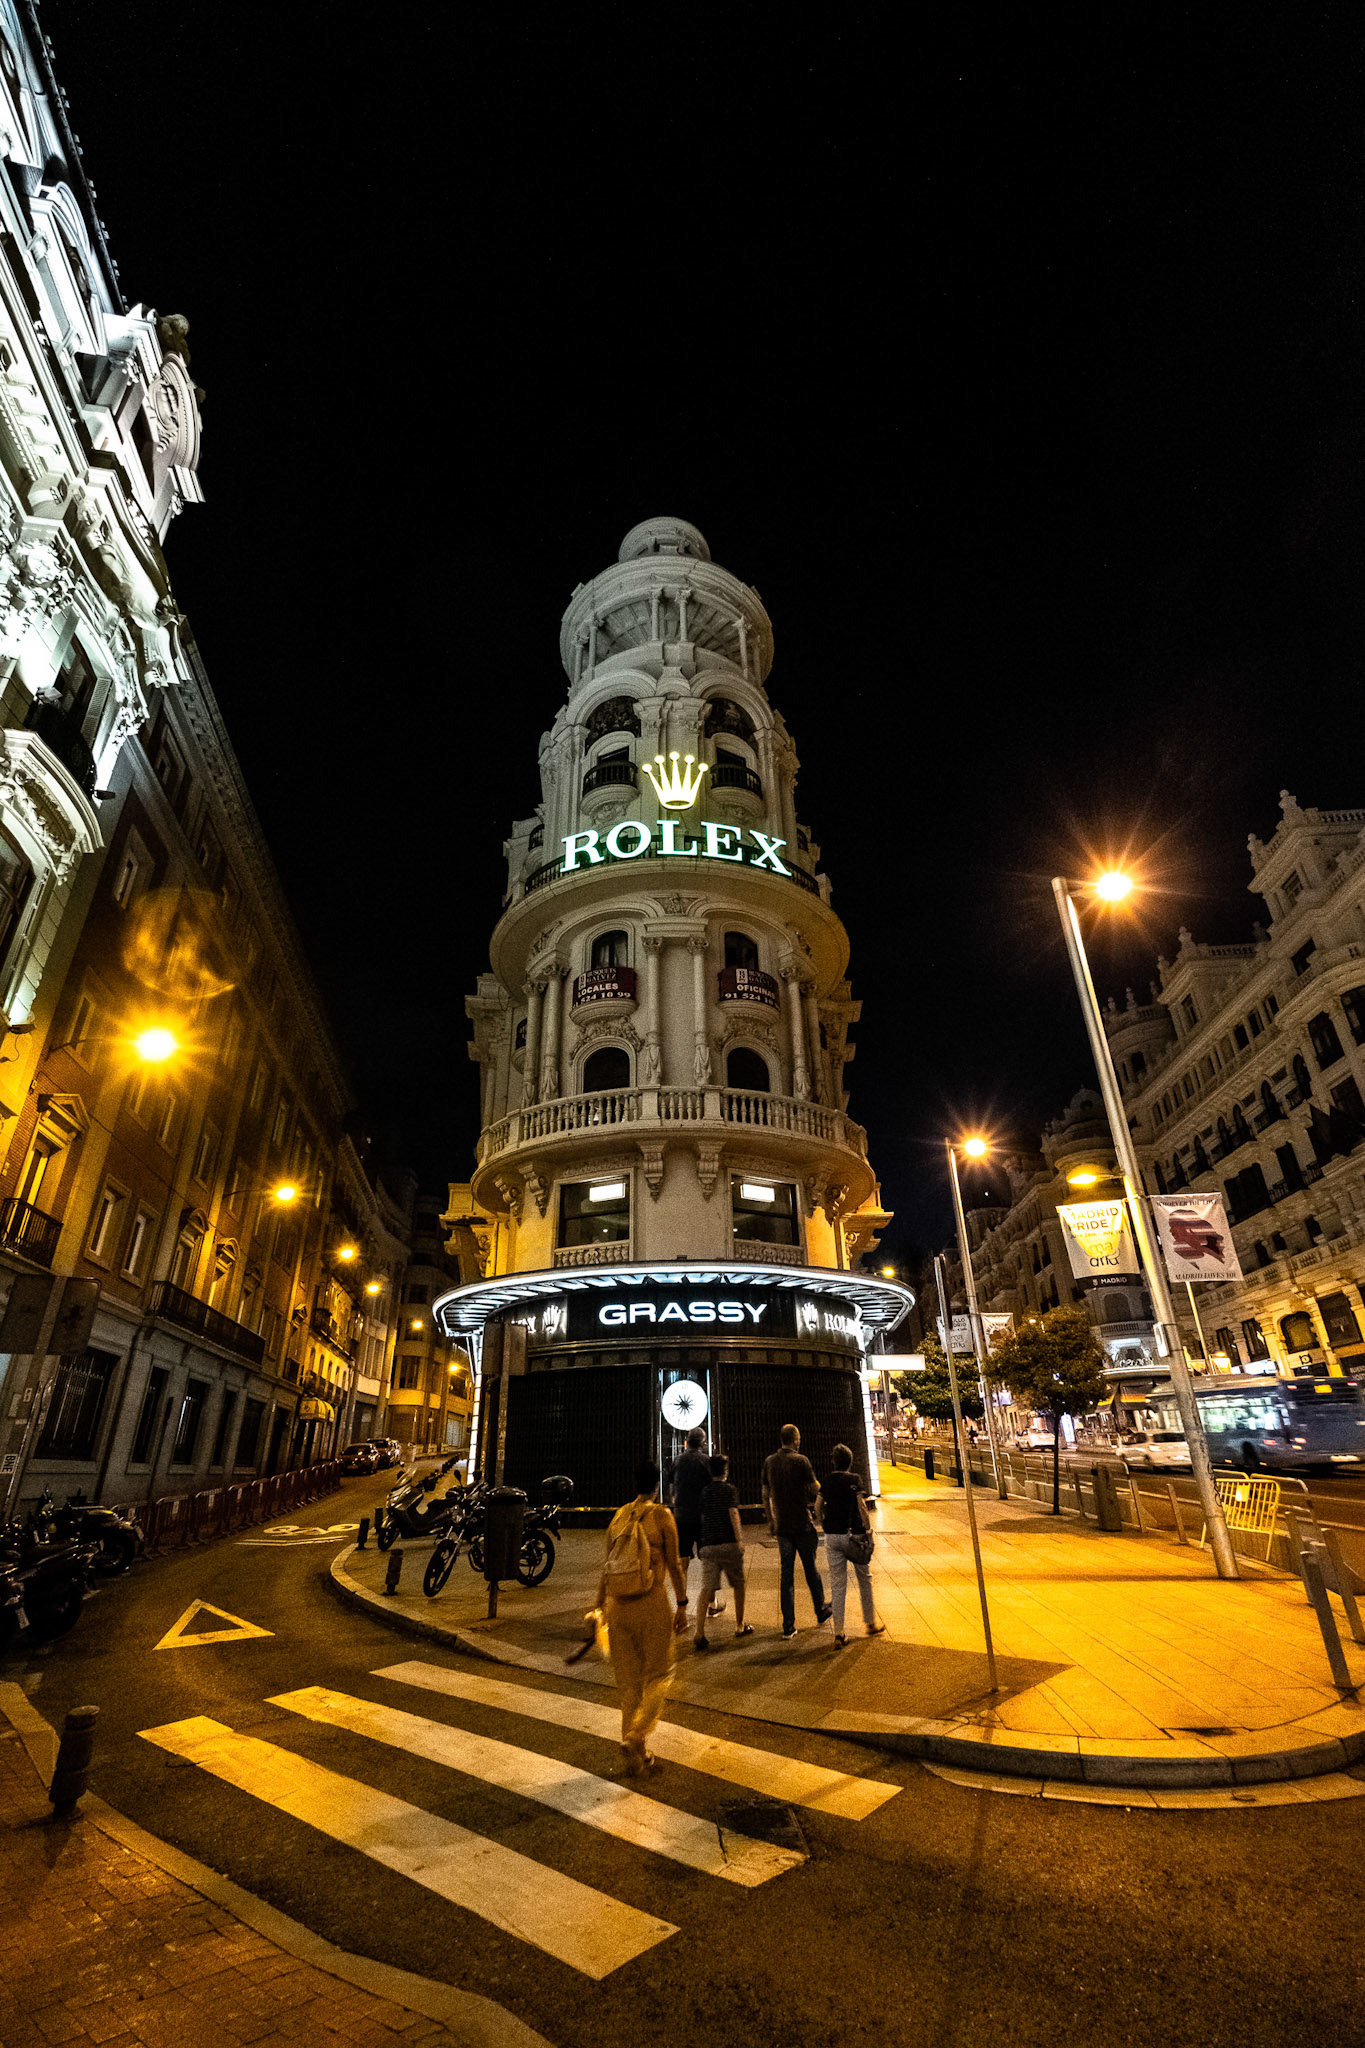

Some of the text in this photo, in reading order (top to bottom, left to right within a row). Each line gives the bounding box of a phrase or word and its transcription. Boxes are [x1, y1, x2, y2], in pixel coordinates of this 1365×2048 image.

[559, 820, 792, 876] ROLEX
[578, 982, 619, 998] LOCALES
[742, 993, 761, 1001] 524
[1069, 1219, 1109, 1231] PRIDE
[1100, 1277, 1128, 1285] MADRID
[598, 1301, 767, 1326] GRASSY
